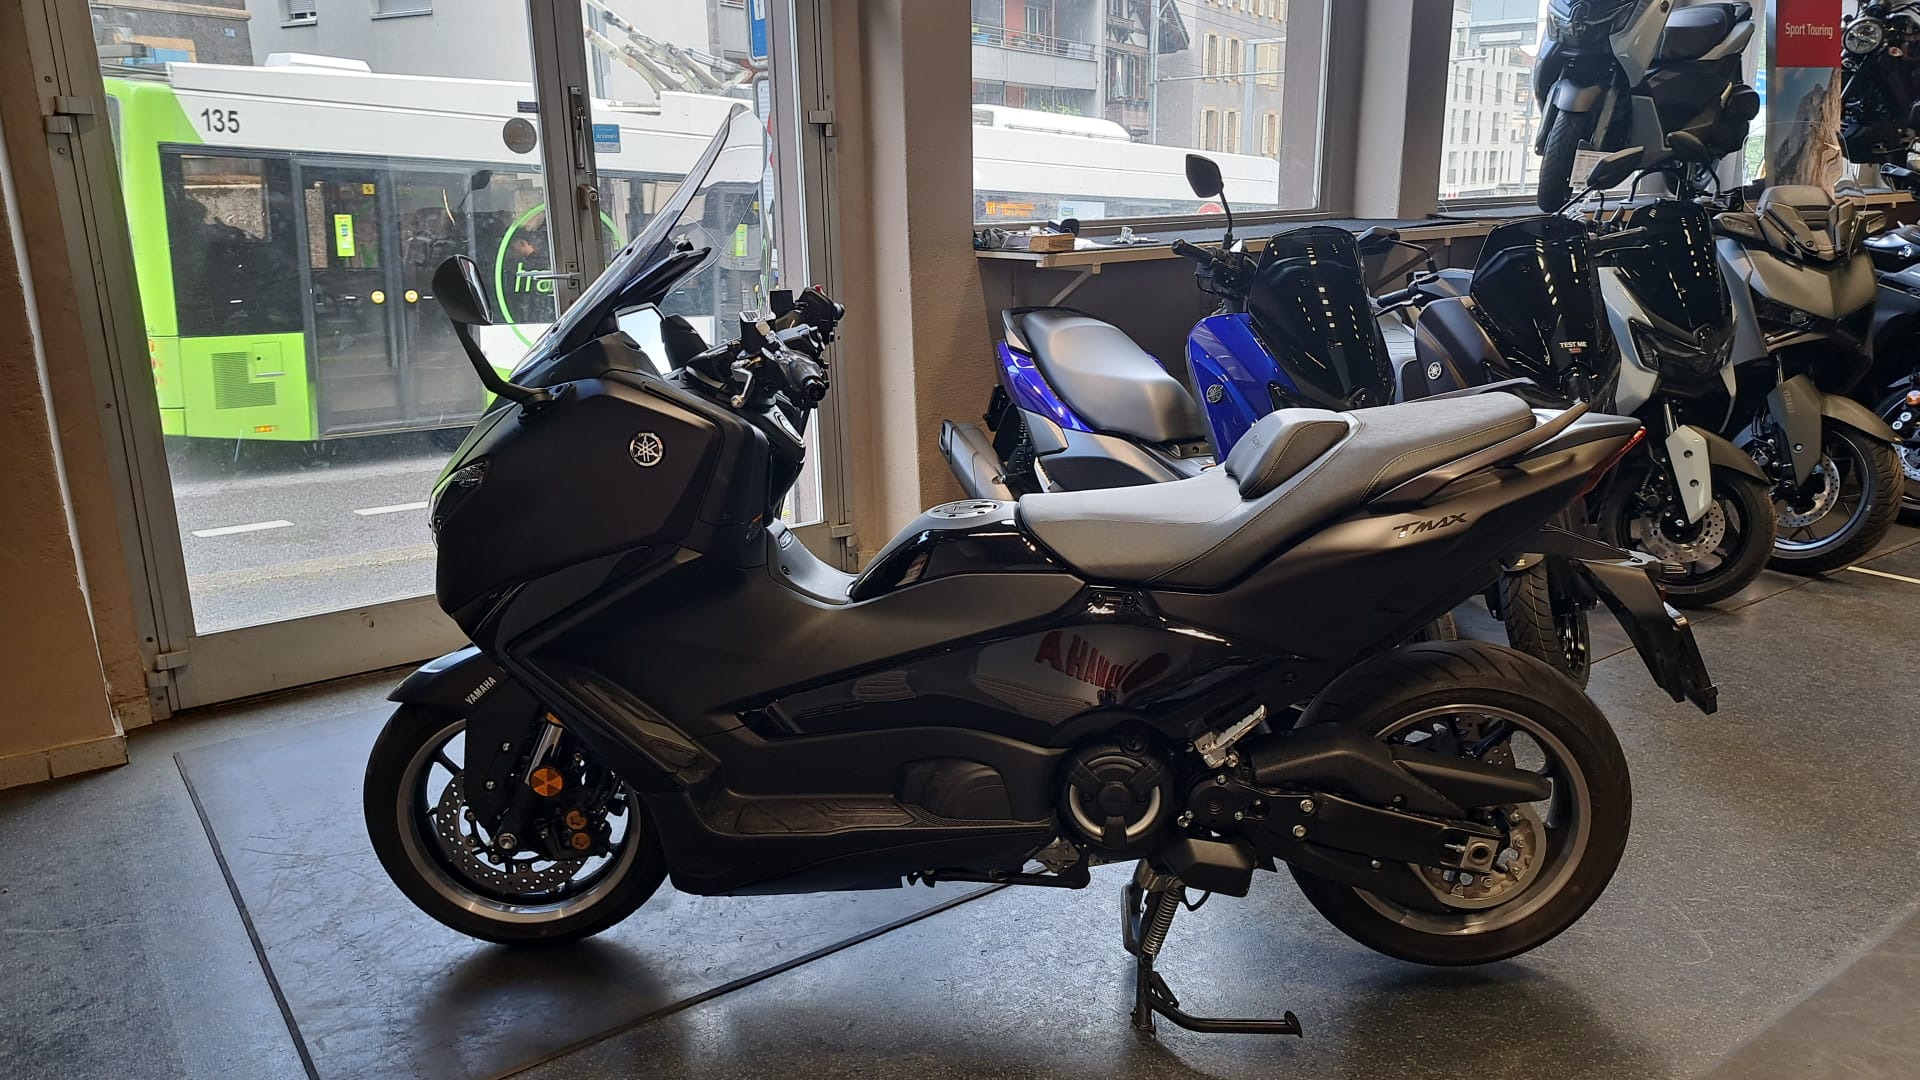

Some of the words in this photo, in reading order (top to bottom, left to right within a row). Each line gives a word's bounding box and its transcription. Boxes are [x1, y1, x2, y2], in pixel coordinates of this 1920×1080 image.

[1785, 22, 1805, 38] Sport
[1807, 23, 1833, 40] Touring
[201, 108, 240, 134] 135
[1559, 341, 1577, 349] TEST
[1392, 512, 1467, 539] TMAX
[464, 676, 497, 705] YAMAHA
